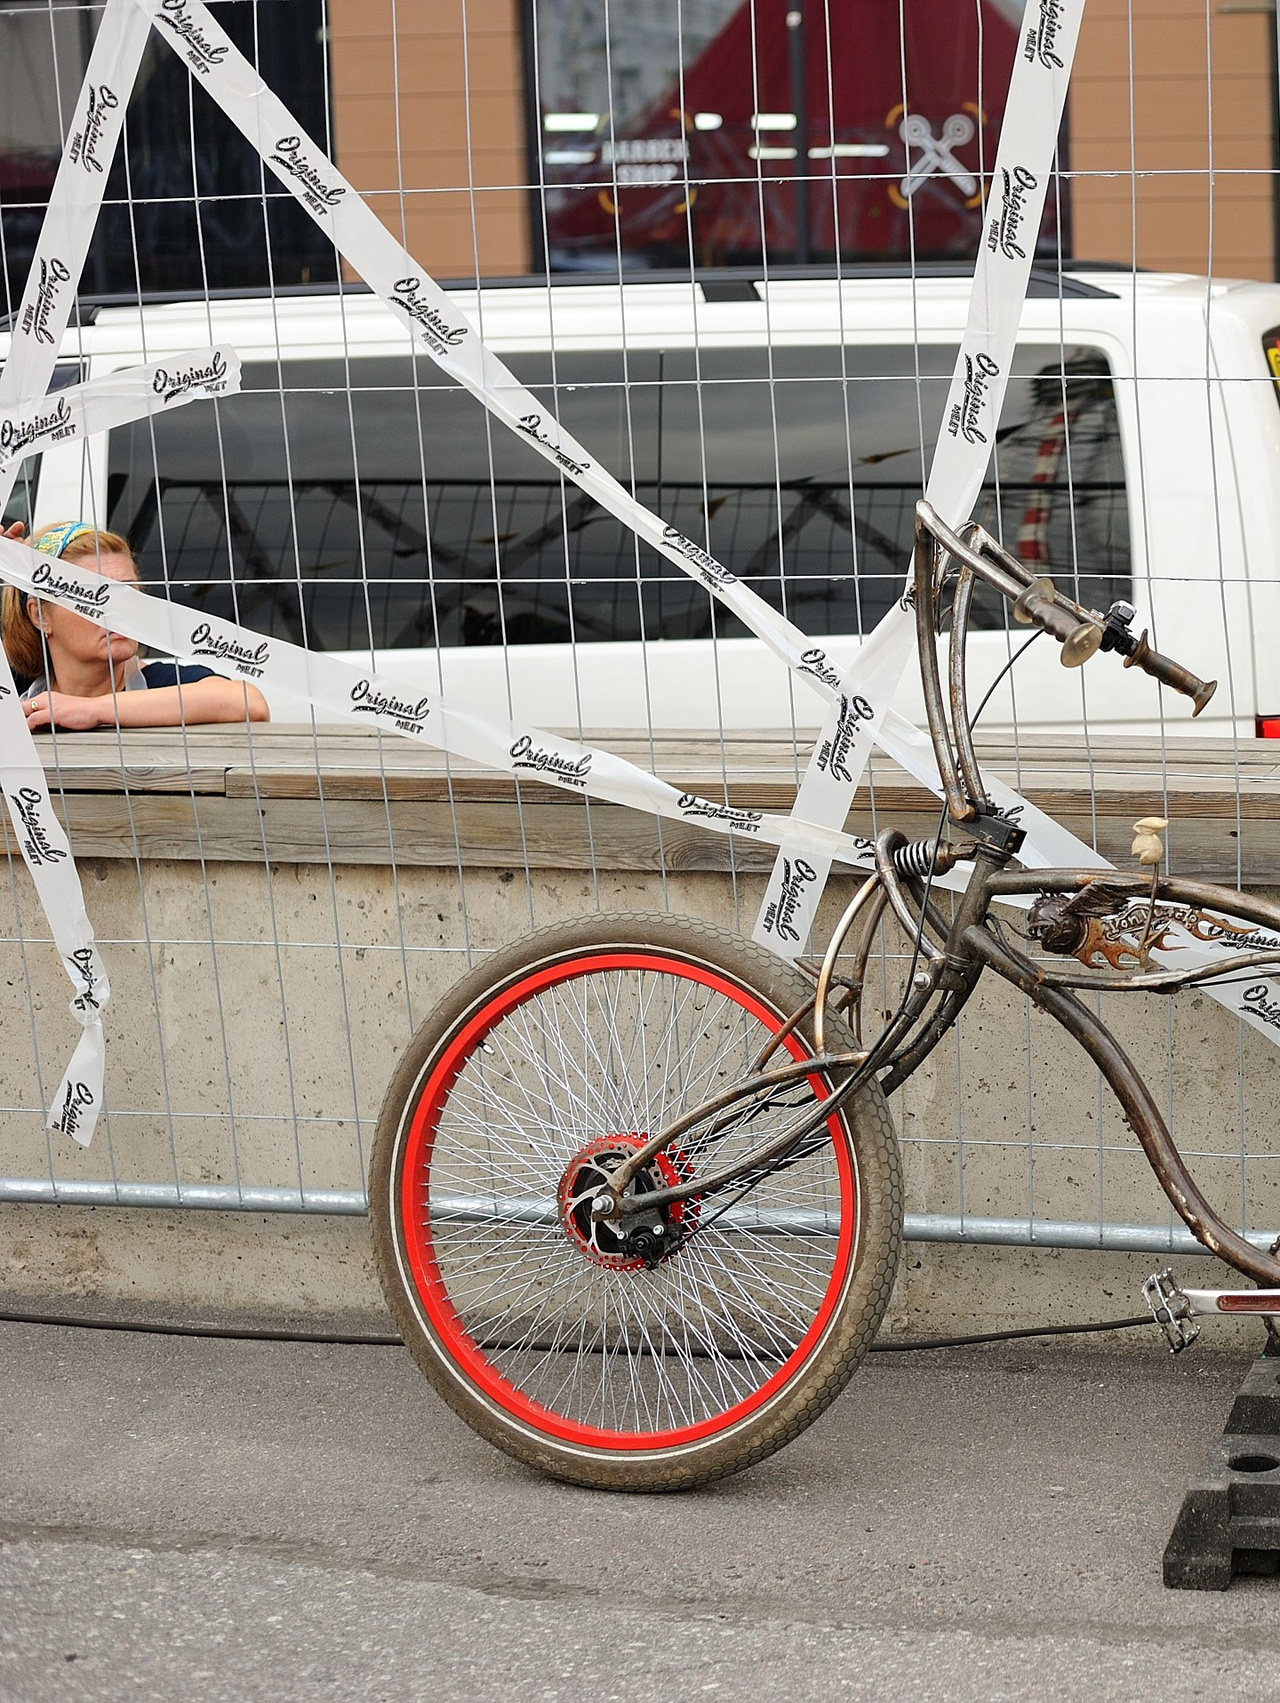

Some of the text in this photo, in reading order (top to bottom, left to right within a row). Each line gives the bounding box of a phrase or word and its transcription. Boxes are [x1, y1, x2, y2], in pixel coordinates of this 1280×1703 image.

[154, 0, 228, 65] Original
[1024, 28, 1037, 62] MEET
[1040, 0, 1064, 69] iginal
[186, 50, 210, 75] MEET
[68, 132, 82, 164] MEET
[82, 84, 118, 173] Original
[268, 136, 346, 206] Original
[303, 191, 328, 216] MEET
[1000, 165, 1037, 260] Original
[987, 219, 1000, 252] MEET
[21, 304, 34, 335] MEET
[34, 256, 70, 345] Original
[388, 277, 467, 346] Original
[421, 331, 448, 356] MEET
[153, 352, 227, 403] Original
[961, 353, 1000, 444] Original
[1, 397, 71, 455] Original
[51, 424, 77, 441] MEET
[948, 404, 962, 437] MEET
[31, 563, 110, 606] Original
[75, 604, 104, 619] MEET
[190, 623, 270, 666] Original
[235, 664, 264, 678] MEET
[350, 679, 430, 721] Original
[395, 720, 424, 734] MEET
[830, 693, 874, 783] Original
[510, 735, 592, 778] Original
[817, 740, 832, 771] MEET
[558, 775, 587, 788] MEET
[10, 787, 67, 863] Original
[729, 821, 761, 833] MEET
[24, 840, 42, 865] MEET
[763, 902, 777, 933] MEET
[776, 857, 818, 942] Original
[61, 1080, 93, 1138] Origin
